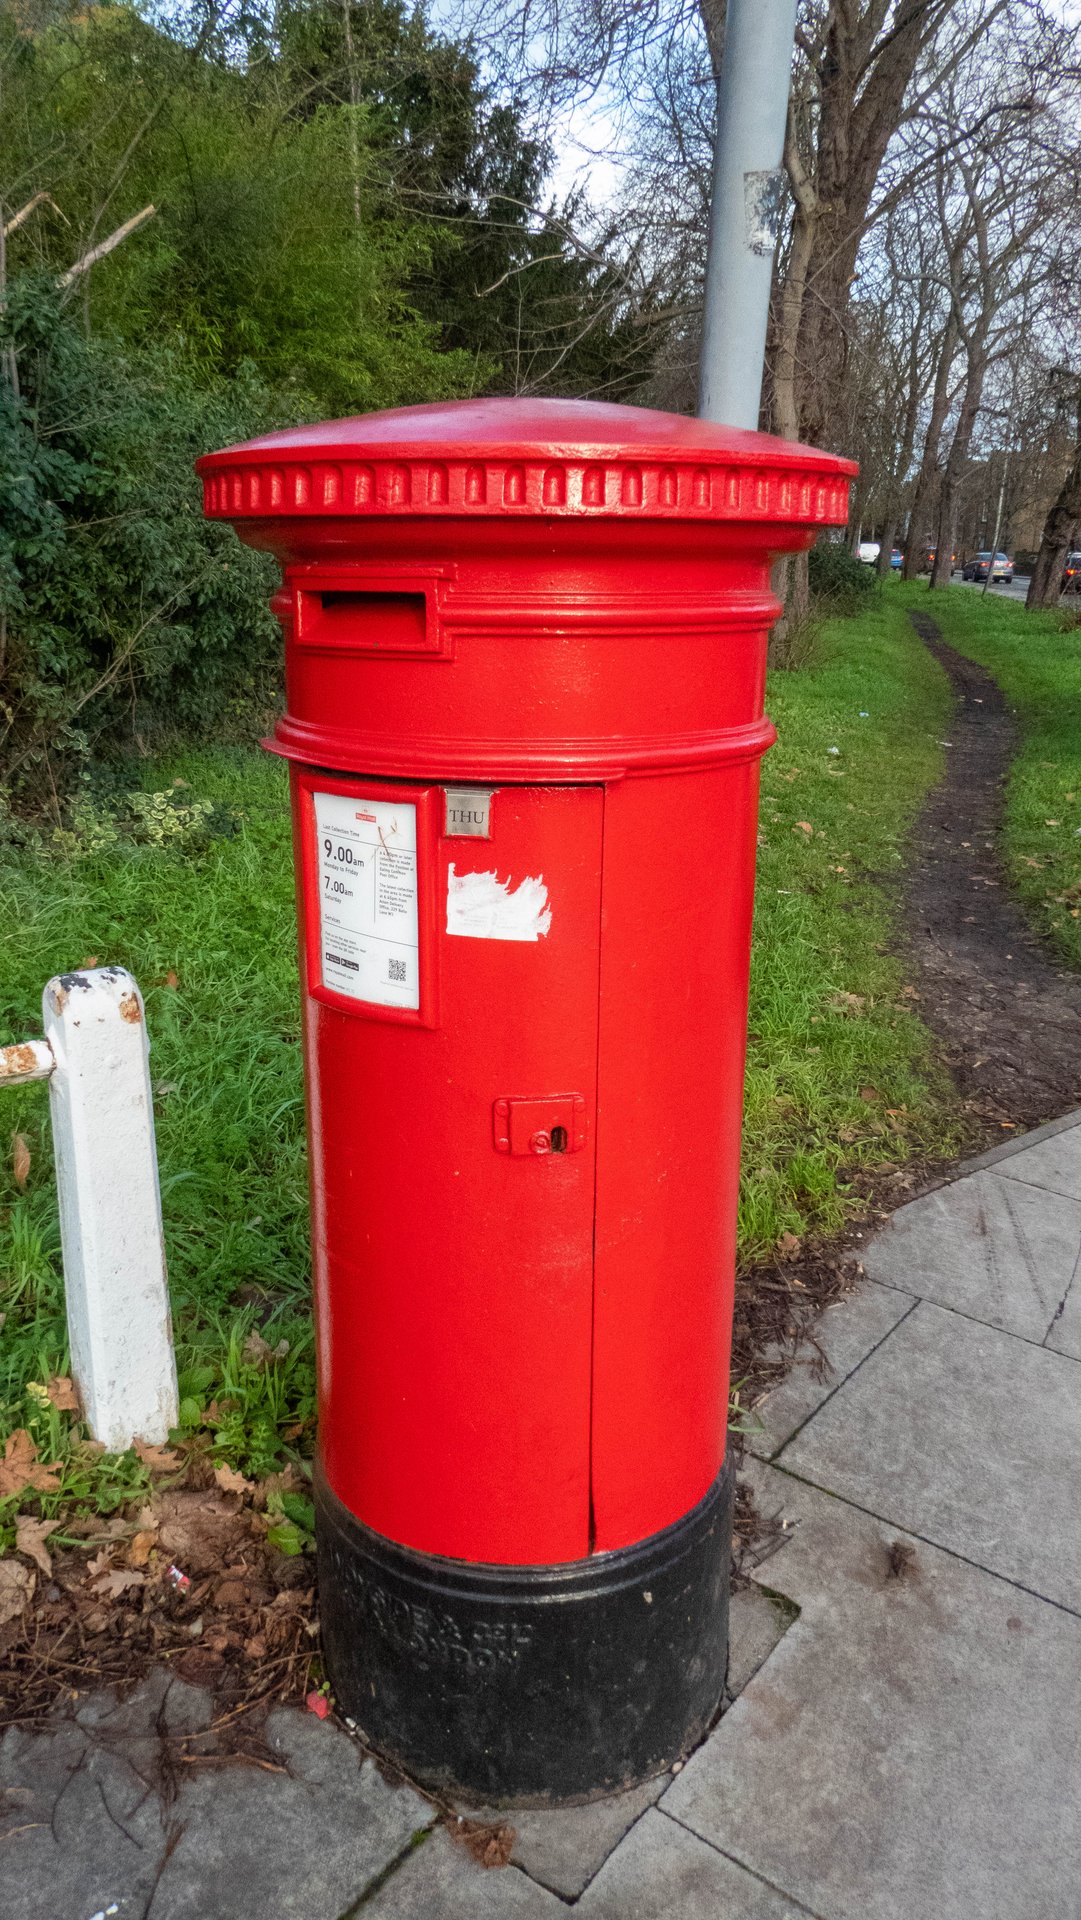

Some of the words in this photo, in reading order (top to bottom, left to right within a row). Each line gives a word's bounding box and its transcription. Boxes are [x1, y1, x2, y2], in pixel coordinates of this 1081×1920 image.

[450, 809, 485, 824] THU
[331, 826, 349, 834] Collection
[324, 839, 364, 867] 9.00am
[324, 862, 339, 872] Monday
[345, 867, 358, 876] Friday
[324, 876, 353, 896] 7.00am
[324, 893, 341, 904] Saturday
[324, 914, 341, 924] Services
